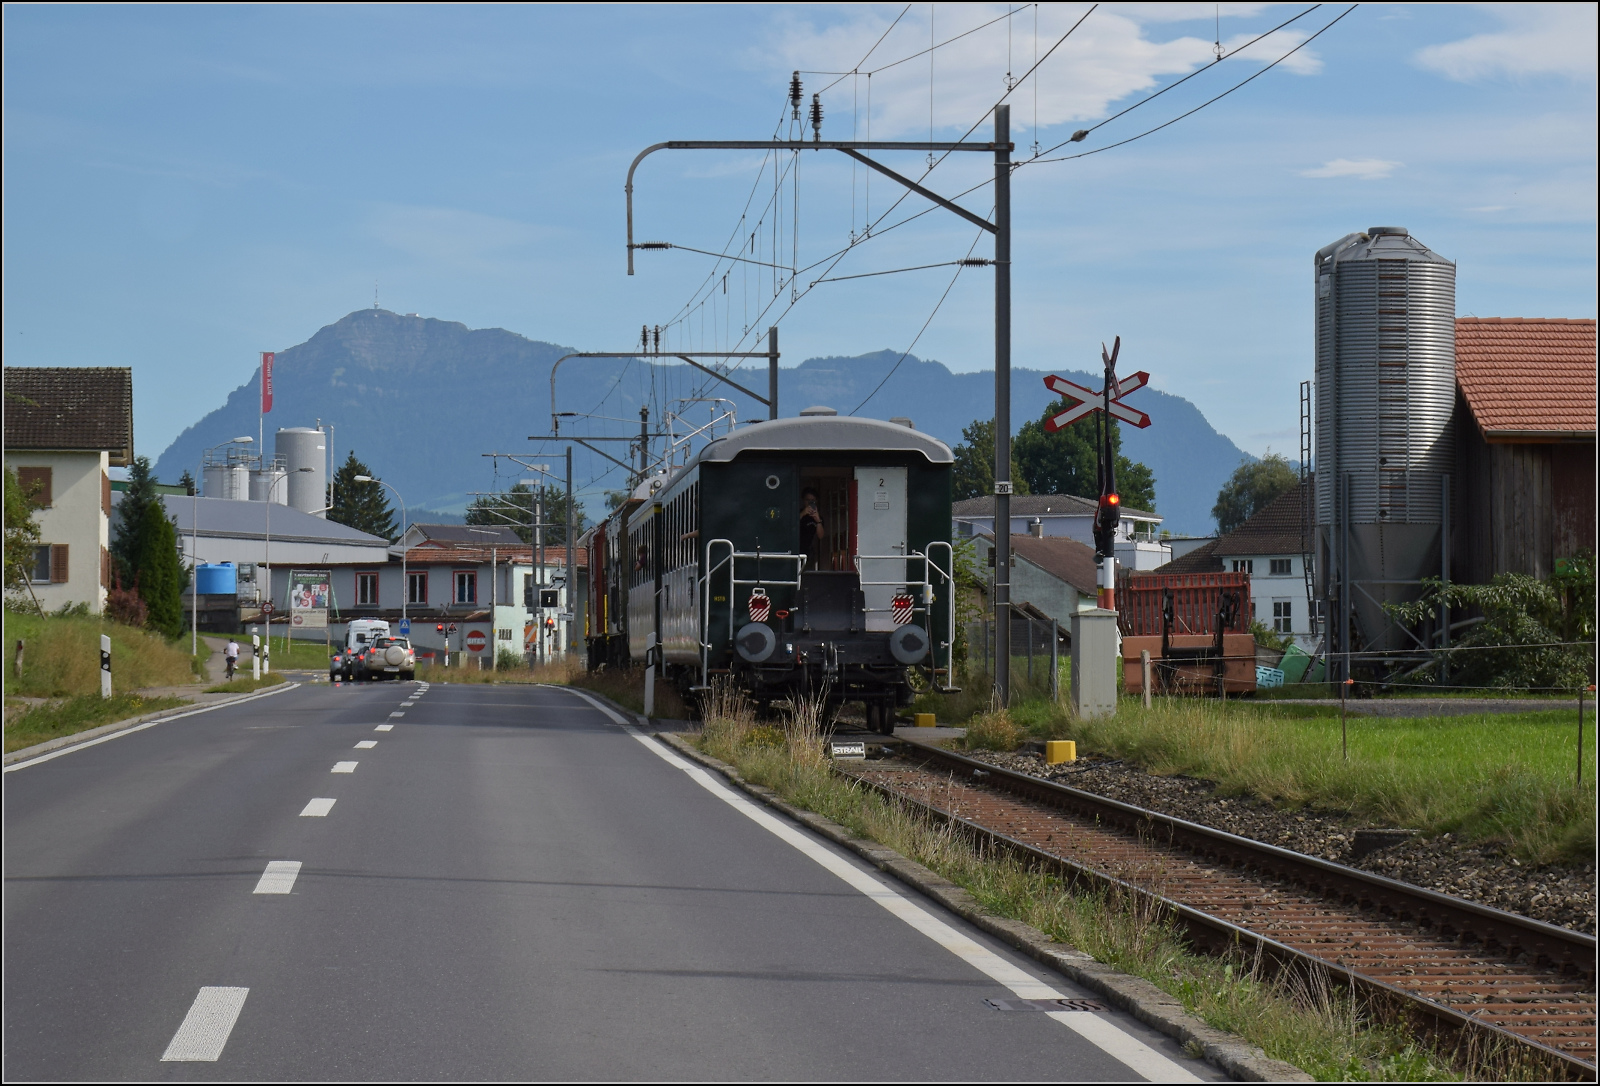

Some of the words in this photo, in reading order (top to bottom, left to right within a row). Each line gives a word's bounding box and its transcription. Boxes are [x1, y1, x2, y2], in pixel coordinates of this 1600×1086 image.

[879, 478, 885, 487] 2
[998, 484, 1009, 493] 20
[833, 746, 864, 754] STRAIL
